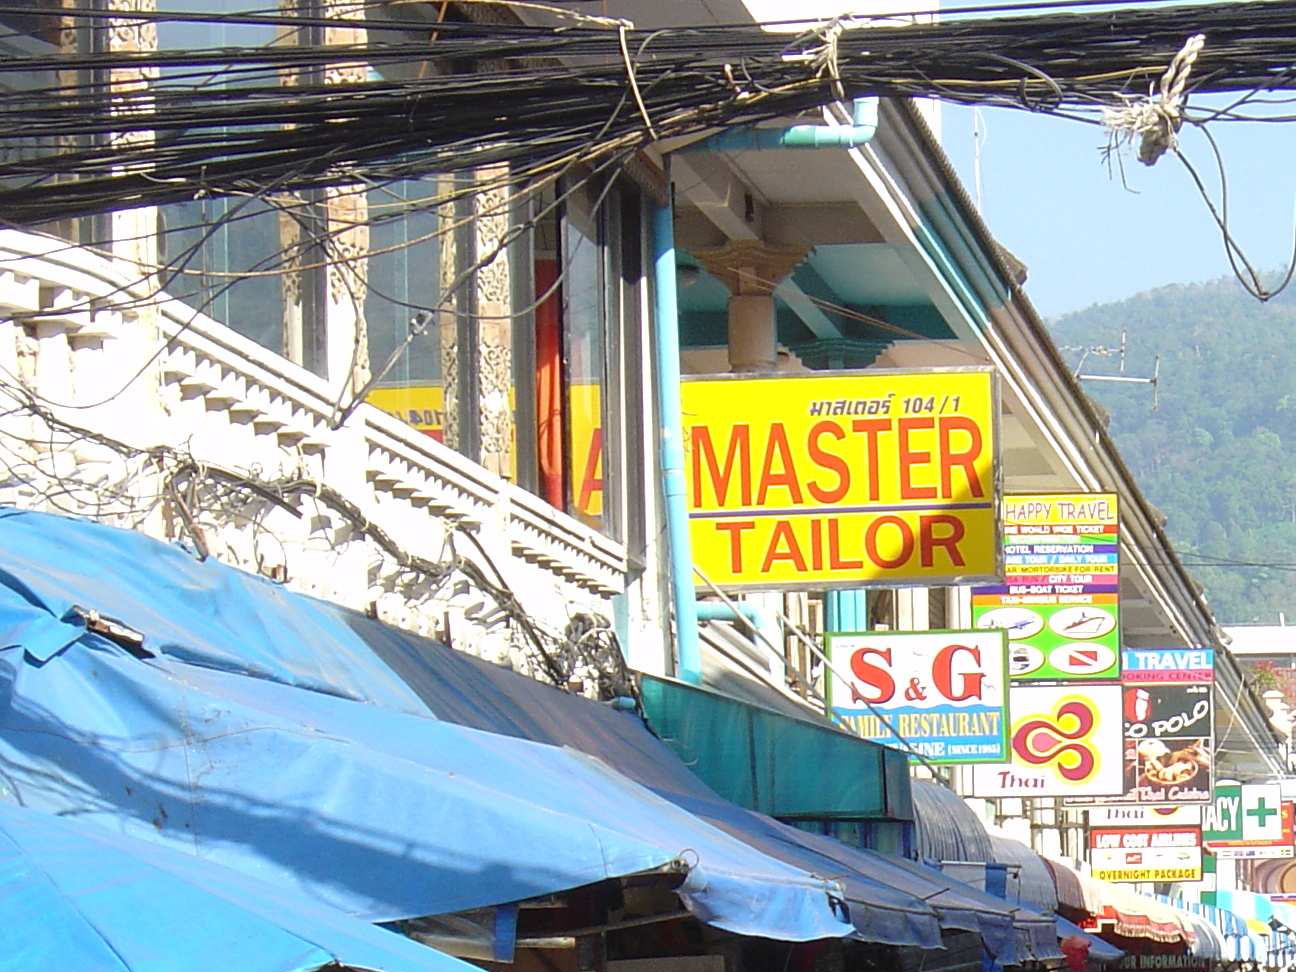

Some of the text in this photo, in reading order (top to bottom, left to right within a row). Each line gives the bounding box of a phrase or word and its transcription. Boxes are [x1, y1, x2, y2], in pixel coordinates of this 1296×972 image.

[809, 393, 896, 416] มาสเตอร์
[691, 416, 985, 508] MASTER
[1005, 501, 1115, 521] HAPPY TRAVEL
[715, 515, 966, 574] TAILOR
[1136, 652, 1213, 669] TRAVEL
[850, 644, 987, 704] S & G
[898, 711, 1000, 738] RESTAURANT
[1152, 699, 1209, 736] POLO
[997, 771, 1046, 789] Thai
[1095, 833, 1121, 848] LOW
[1099, 868, 1196, 880] OVERNIGHT PACKAGE
